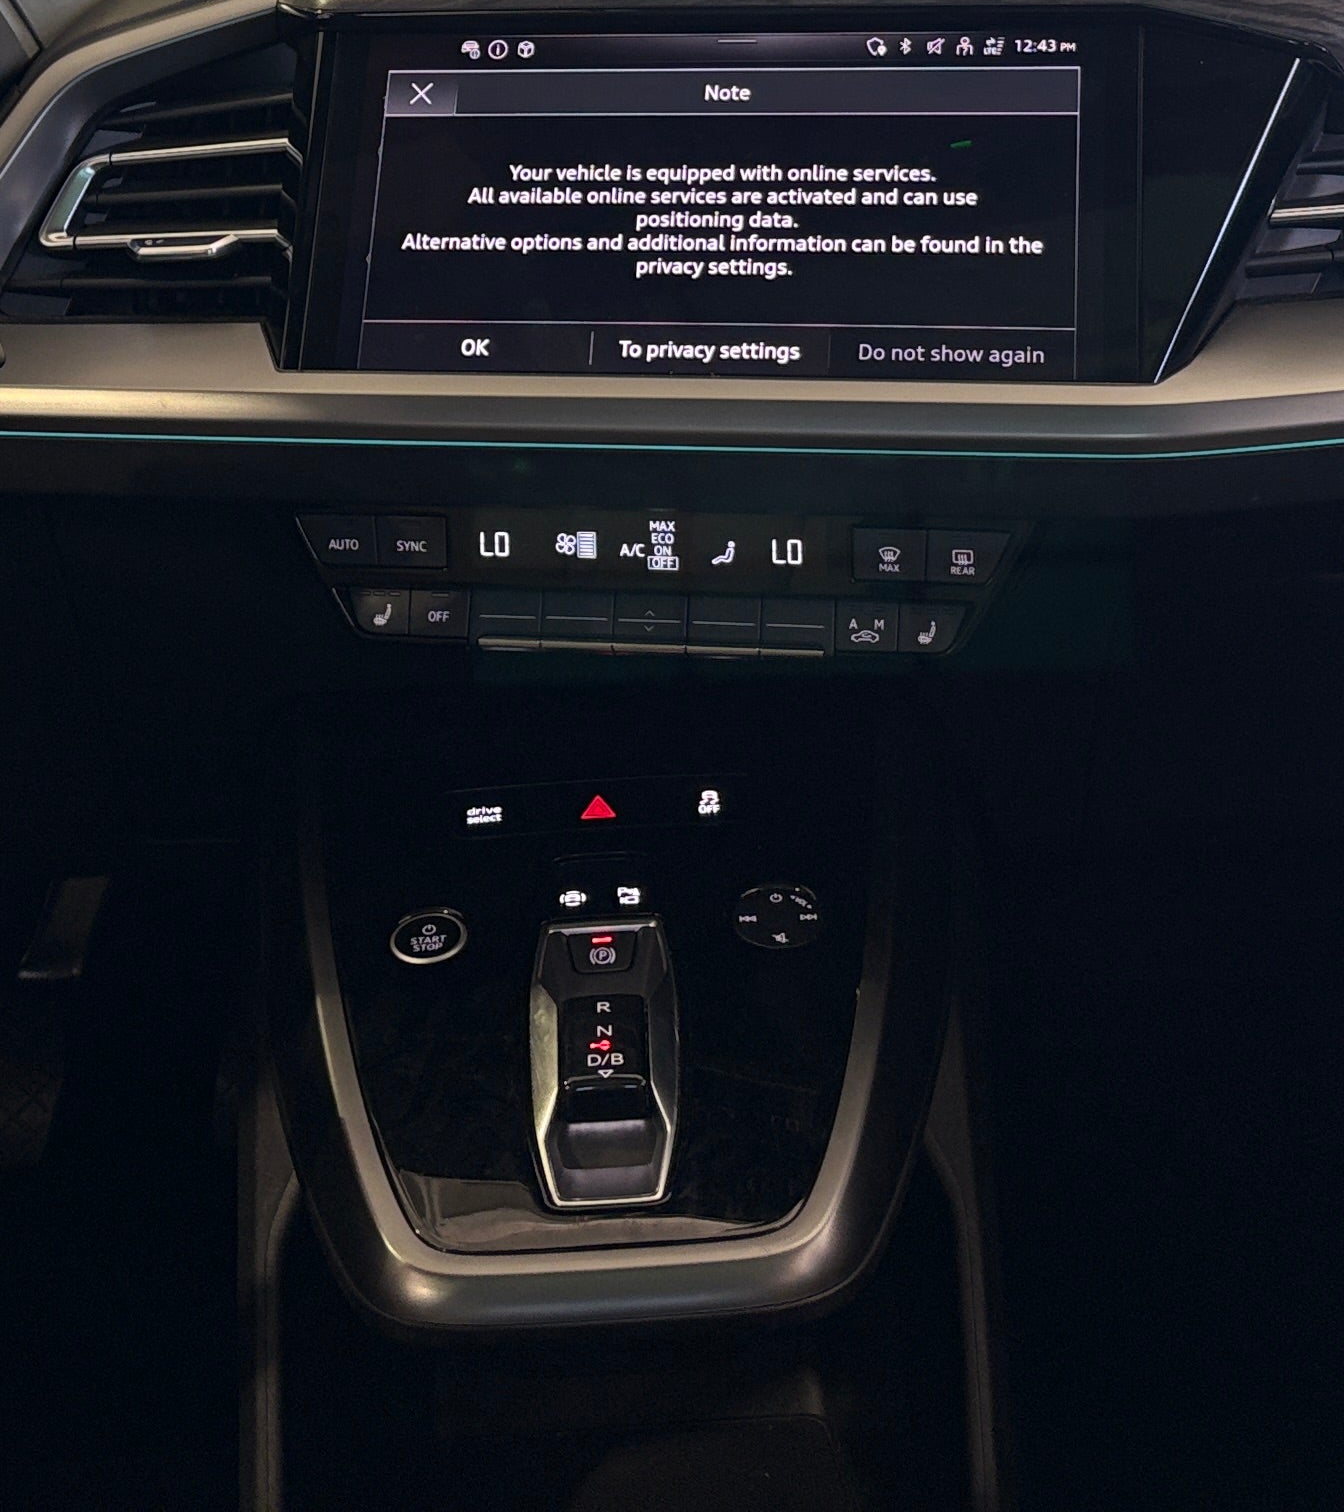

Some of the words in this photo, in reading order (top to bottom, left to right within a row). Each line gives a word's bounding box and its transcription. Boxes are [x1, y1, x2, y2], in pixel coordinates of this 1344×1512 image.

[1014, 39, 1056, 53] 12:43
[1059, 42, 1076, 52] PM
[703, 83, 752, 103] Note
[509, 164, 553, 182] Your
[555, 164, 622, 182] vehicle
[626, 164, 642, 182] is
[646, 164, 735, 185] equipped
[739, 164, 783, 182] with
[787, 164, 848, 182] online
[853, 165, 937, 182] services.
[467, 187, 495, 204] All
[498, 187, 582, 205] available
[586, 187, 646, 205] online
[650, 188, 727, 205] services
[731, 191, 763, 205] are
[766, 188, 857, 206] activated
[861, 188, 898, 206] and
[903, 191, 938, 206] can
[943, 191, 978, 206] use
[635, 211, 744, 232] positioning
[749, 211, 799, 229] data.
[401, 233, 506, 251] Alternative
[510, 233, 583, 254] options
[586, 234, 623, 251] and
[627, 234, 726, 252] additional
[730, 235, 847, 253] information
[851, 238, 886, 253] can
[891, 235, 916, 253] be
[920, 235, 980, 253] found
[985, 236, 1004, 254] in
[1009, 236, 1044, 254] the
[635, 258, 704, 279] privacy
[708, 259, 793, 280] settings.
[460, 338, 491, 357] OK
[618, 340, 642, 358] To
[645, 341, 716, 363] privacy
[719, 341, 802, 364] settings
[858, 343, 885, 360] Do
[891, 344, 925, 361] not
[930, 344, 984, 363] show
[988, 346, 1045, 367] again
[649, 520, 675, 532] MAX
[650, 532, 674, 544] ECO
[328, 539, 359, 551] AUTO
[396, 540, 427, 553] SYNC
[619, 543, 646, 557] A/C
[653, 545, 672, 556] ON
[651, 557, 676, 569] OFF
[879, 563, 900, 573] MAX
[949, 566, 976, 576] REAR
[427, 610, 451, 623] OFF
[848, 619, 858, 630] A
[874, 619, 885, 630] M
[466, 805, 503, 816] drive
[697, 803, 721, 815] OFF
[466, 814, 503, 825] select
[410, 934, 448, 946] START
[412, 943, 444, 953] STOP
[596, 1001, 611, 1013] R
[596, 1025, 613, 1037] N
[587, 1053, 625, 1067] D/B
